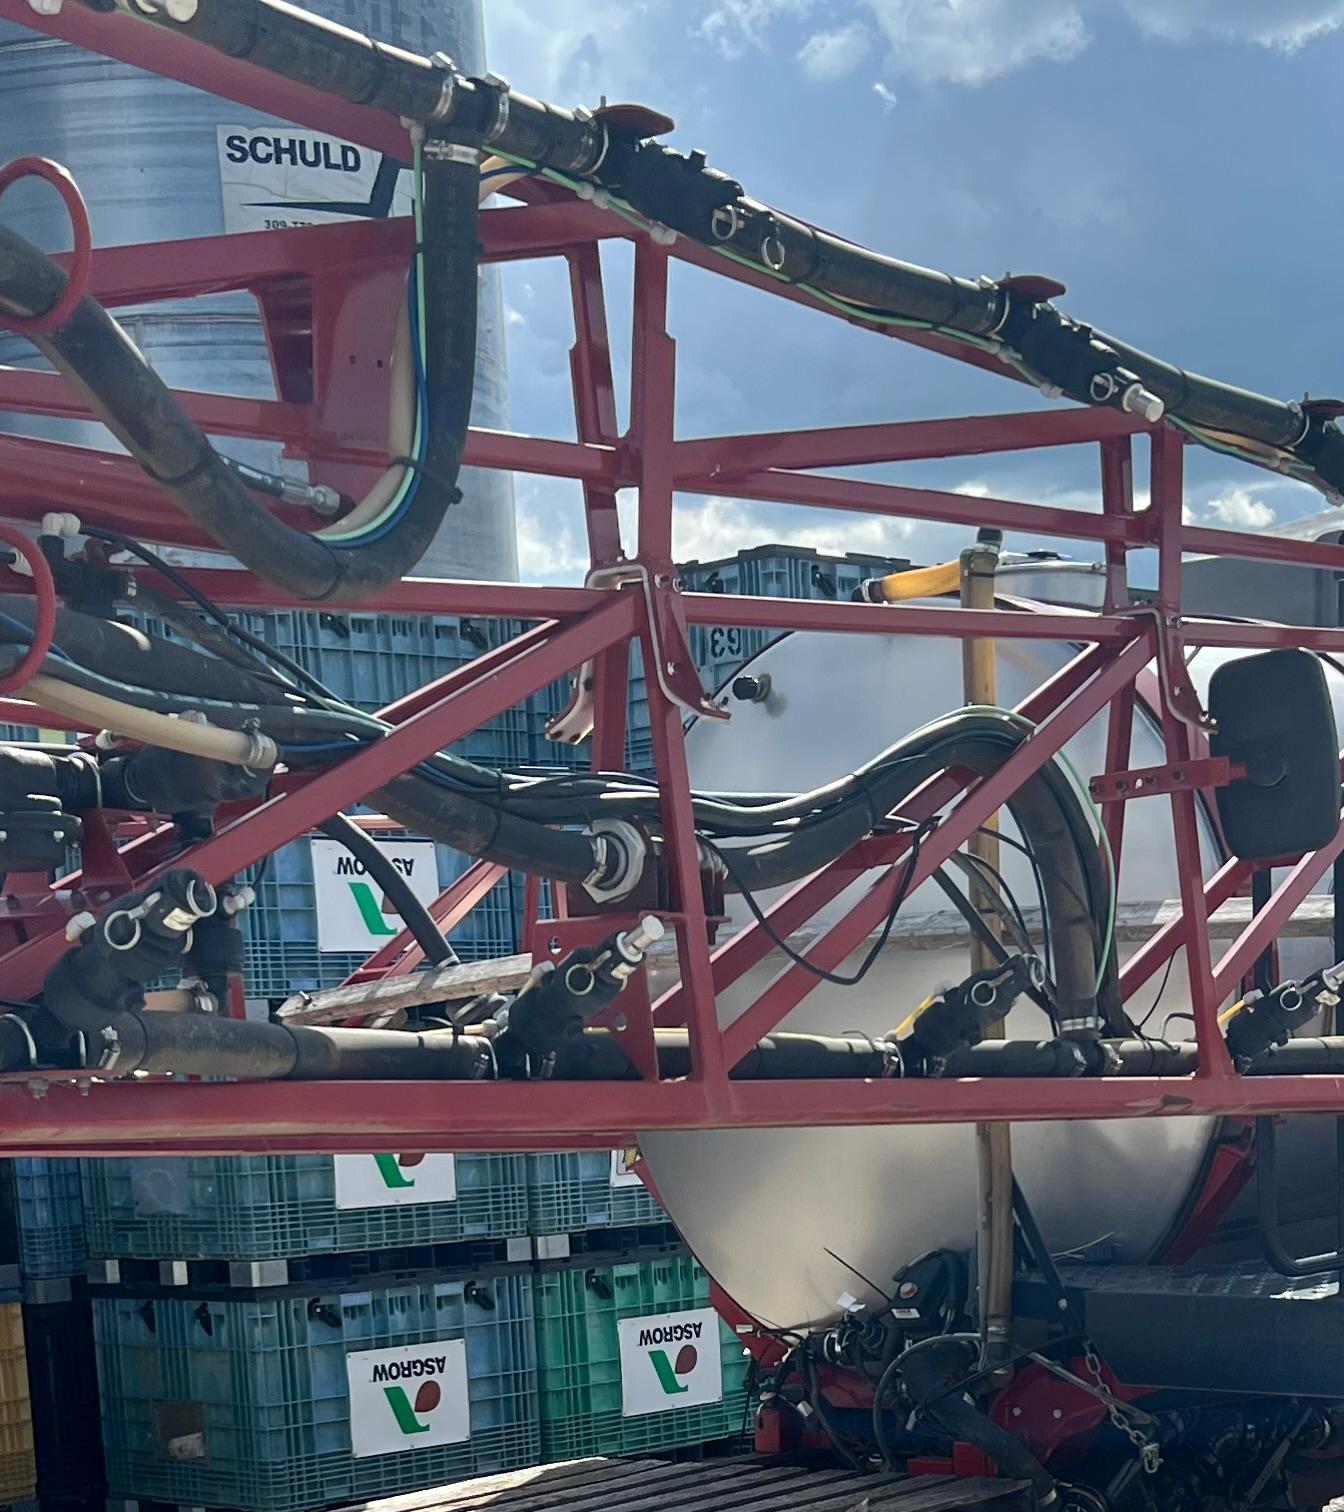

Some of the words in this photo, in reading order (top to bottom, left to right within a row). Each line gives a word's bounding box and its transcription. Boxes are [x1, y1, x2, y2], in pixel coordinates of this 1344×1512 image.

[225, 135, 361, 172] SCHULD
[337, 856, 415, 876] ASOW
[639, 1322, 703, 1346] ASGROW
[372, 1356, 447, 1382] ASGROW
